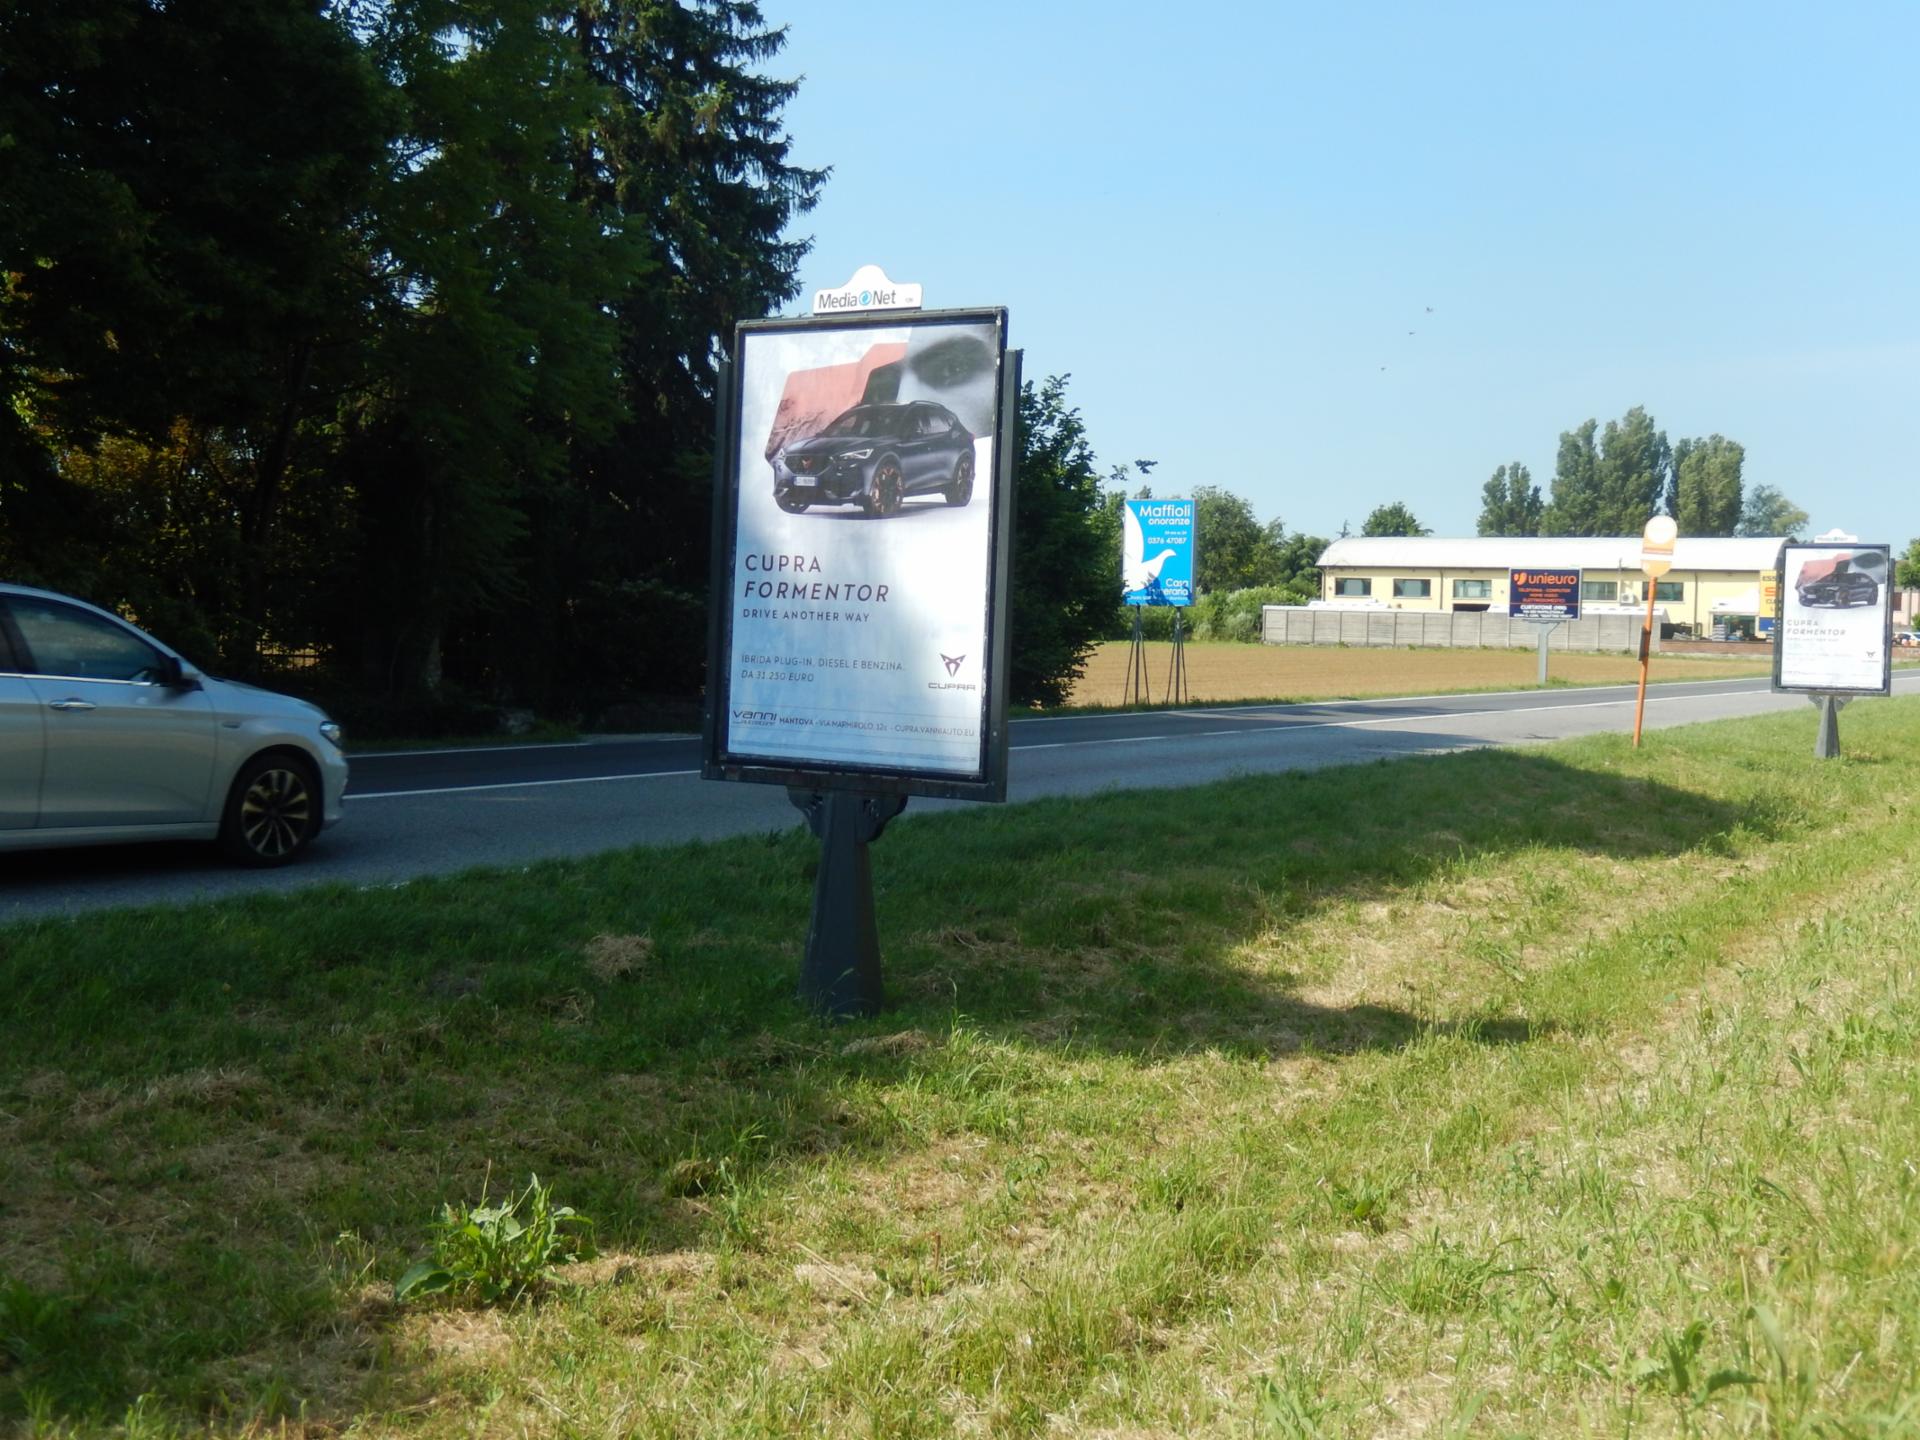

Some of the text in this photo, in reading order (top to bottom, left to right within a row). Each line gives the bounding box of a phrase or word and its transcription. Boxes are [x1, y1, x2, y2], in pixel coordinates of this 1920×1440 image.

[818, 292, 857, 309] Media
[872, 290, 896, 305] Net
[1140, 504, 1191, 517] Maffioli
[1148, 518, 1190, 526] onoranze
[745, 554, 822, 573] CUPRA
[1165, 578, 1189, 587] Casa
[1528, 573, 1577, 585] unieuro
[744, 580, 889, 602] FORMENTOR
[743, 608, 870, 622] DRIVE ANOTHER WAY
[1786, 628, 1846, 636] FORMENTOR
[741, 655, 771, 664] IBRIDA
[818, 658, 850, 669] DIESEL
[853, 660, 858, 669] E
[741, 670, 754, 679] DA
[788, 672, 814, 682] EURO
[928, 682, 976, 691] CUPRA
[733, 710, 777, 721] vanni
[779, 717, 814, 726] MANTOVA
